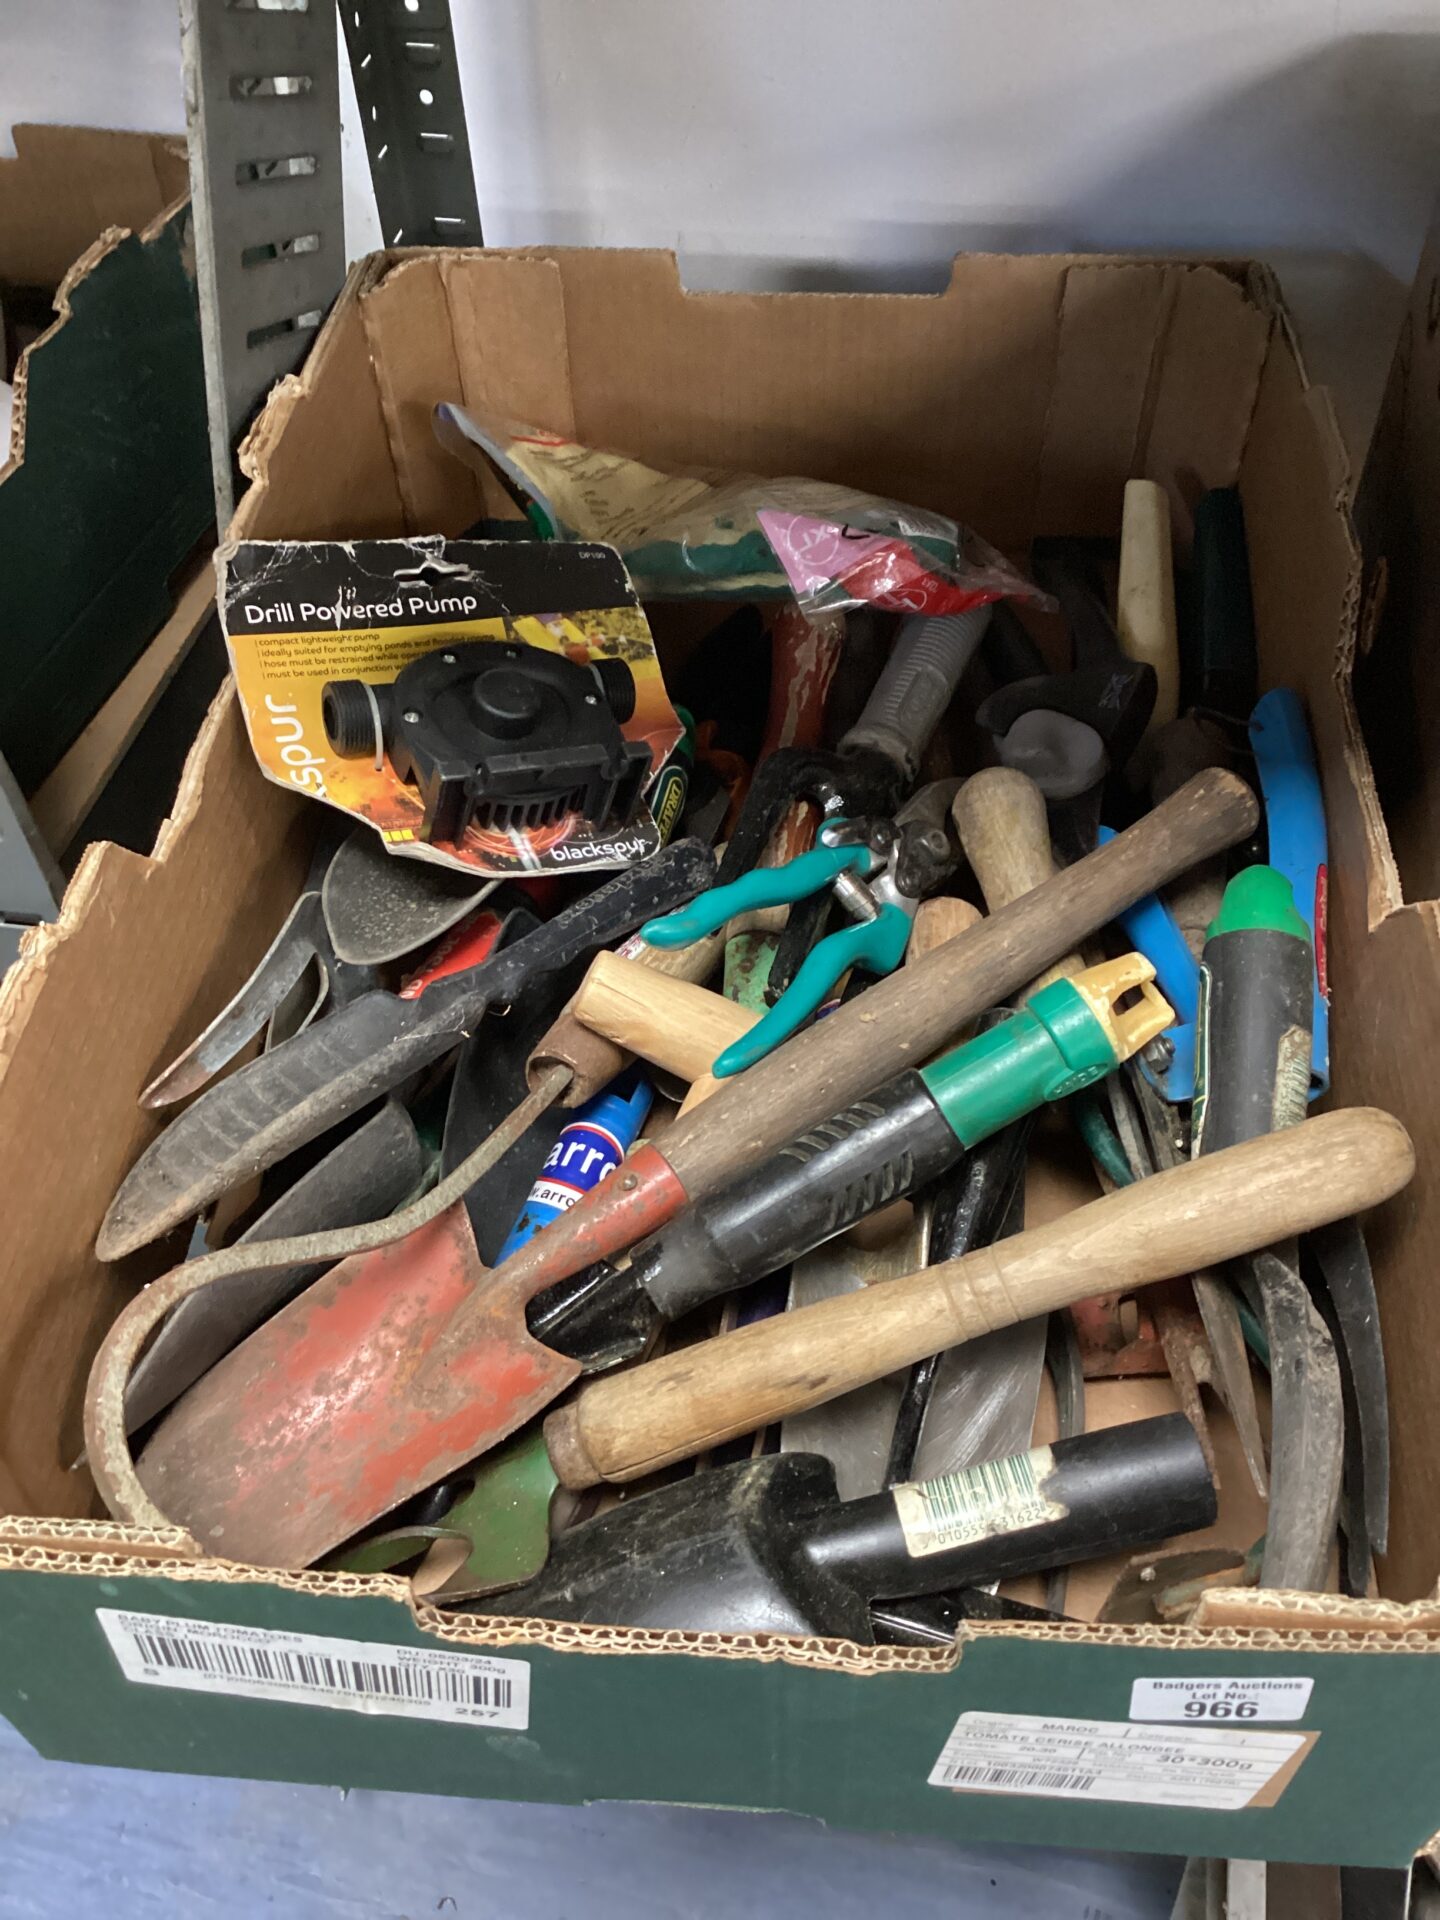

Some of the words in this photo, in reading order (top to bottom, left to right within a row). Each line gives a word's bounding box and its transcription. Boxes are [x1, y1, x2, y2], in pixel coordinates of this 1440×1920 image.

[245, 602, 295, 624] Drill
[300, 598, 404, 622] Powered
[409, 596, 478, 615] Pump
[259, 637, 299, 646] compact
[301, 633, 352, 645] lightweight
[354, 632, 380, 641] pump
[261, 648, 292, 658] ideally
[294, 646, 322, 655] suited
[324, 645, 337, 653] for
[340, 643, 383, 653] emptying
[385, 640, 411, 650] ponds
[264, 660, 287, 668] hose
[290, 658, 313, 666] must
[315, 657, 327, 665] be
[329, 654, 374, 664] restrained
[375, 652, 399, 661] while
[267, 670, 291, 678] must
[293, 669, 305, 677] be
[307, 667, 330, 676] used
[331, 666, 340, 675] in
[342, 664, 393, 675] conjunction
[659, 783, 682, 844] DRAPE
[550, 838, 647, 862] blackspur
[1152, 1681, 1222, 1691] Badgers
[1229, 1681, 1304, 1690] Auctions
[1192, 1691, 1217, 1700] Lot
[1185, 1701, 1260, 1719] 966
[1042, 1723, 1100, 1734] MAROC
[964, 1731, 1030, 1743] TOMATE
[1035, 1737, 1094, 1749] CERISE
[1098, 1741, 1186, 1754] ALLONGEE
